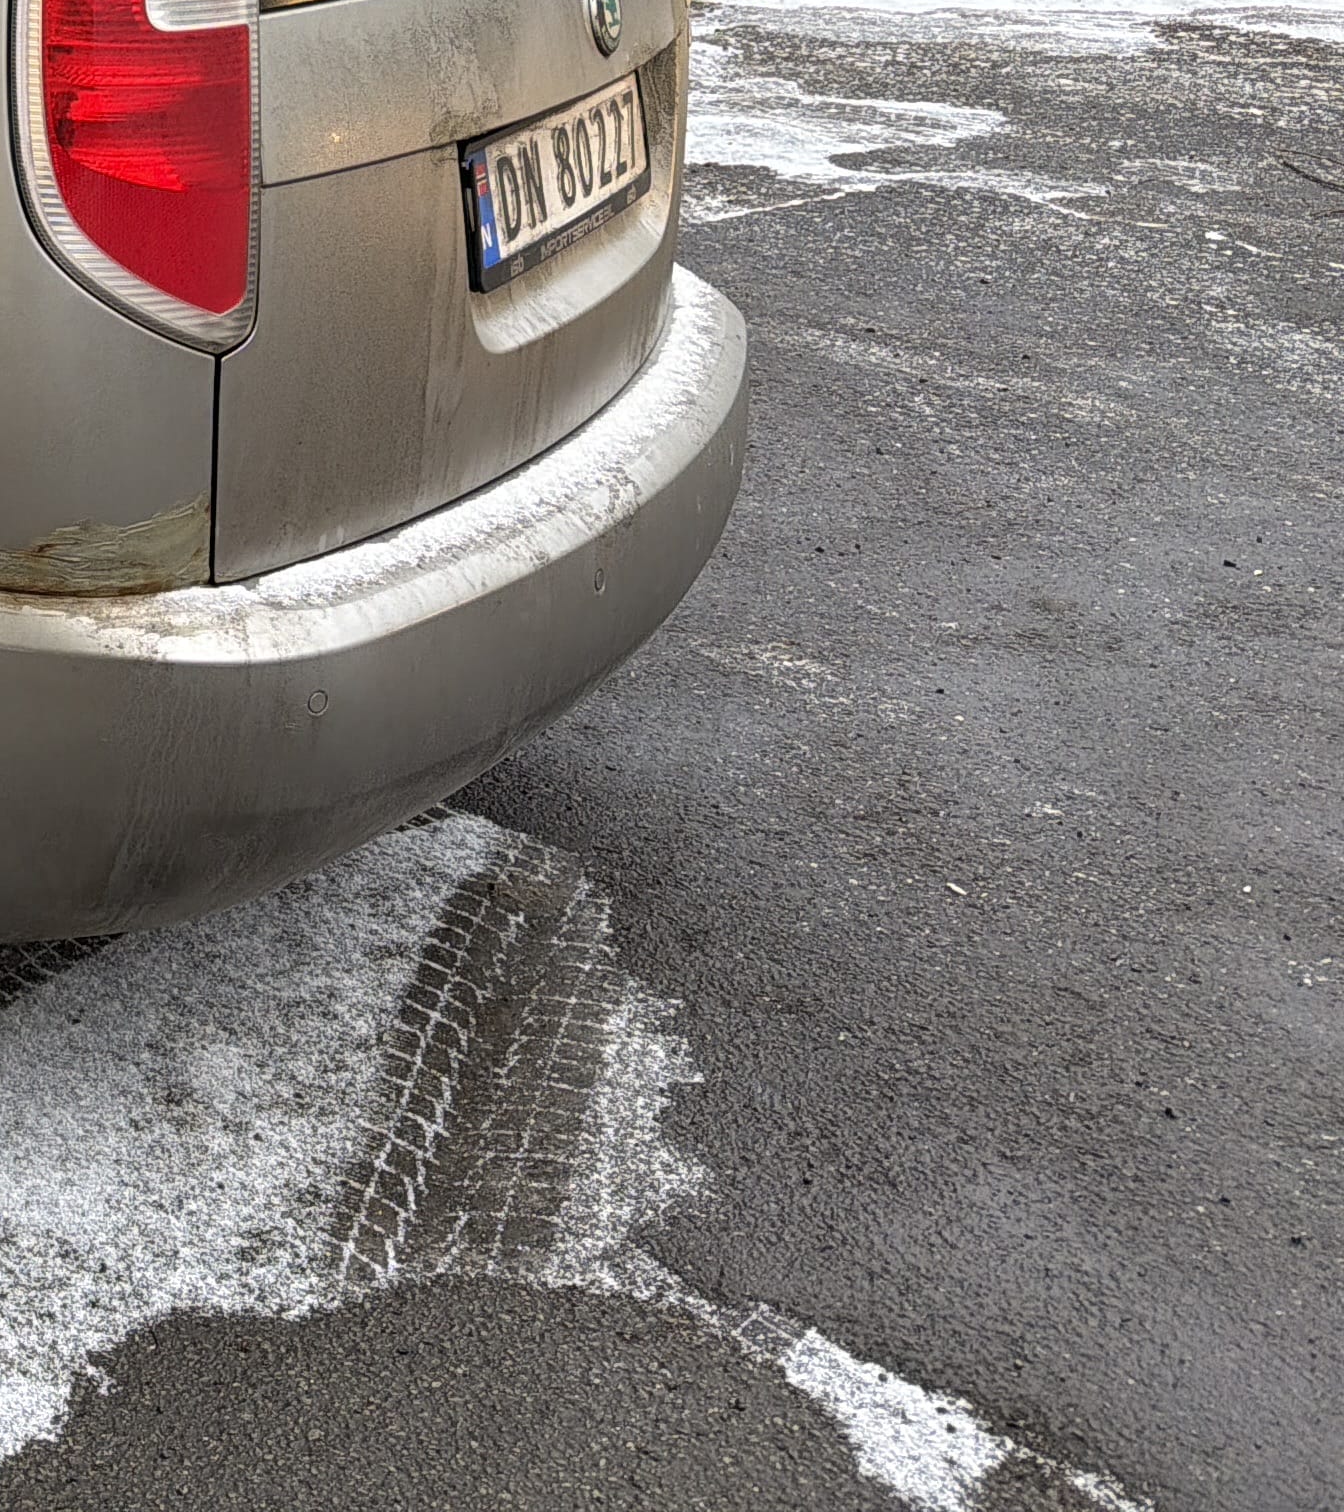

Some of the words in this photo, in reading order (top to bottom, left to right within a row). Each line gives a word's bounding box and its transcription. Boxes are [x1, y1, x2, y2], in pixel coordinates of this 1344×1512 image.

[496, 138, 548, 244] DN
[552, 89, 637, 210] 80227
[480, 223, 494, 250] N
